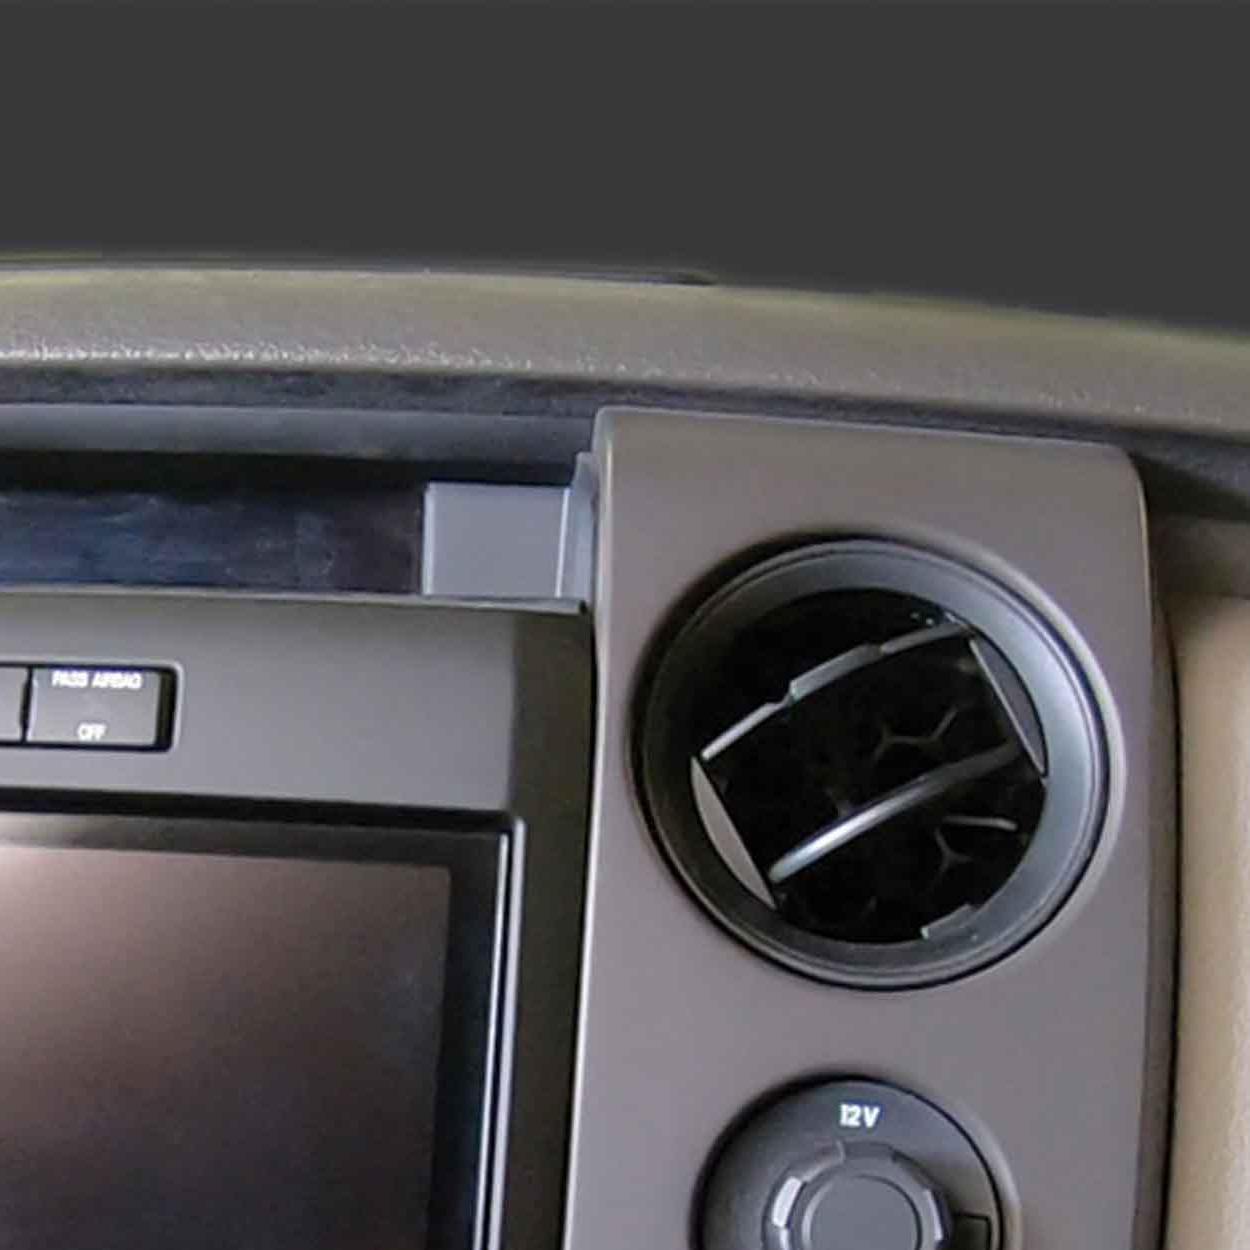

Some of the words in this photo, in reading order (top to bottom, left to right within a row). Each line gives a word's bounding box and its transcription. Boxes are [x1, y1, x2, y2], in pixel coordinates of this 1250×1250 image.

[52, 671, 88, 688] PASS
[91, 672, 142, 690] AIRBAG
[78, 723, 107, 740] OFF
[840, 1104, 880, 1127] 12V
